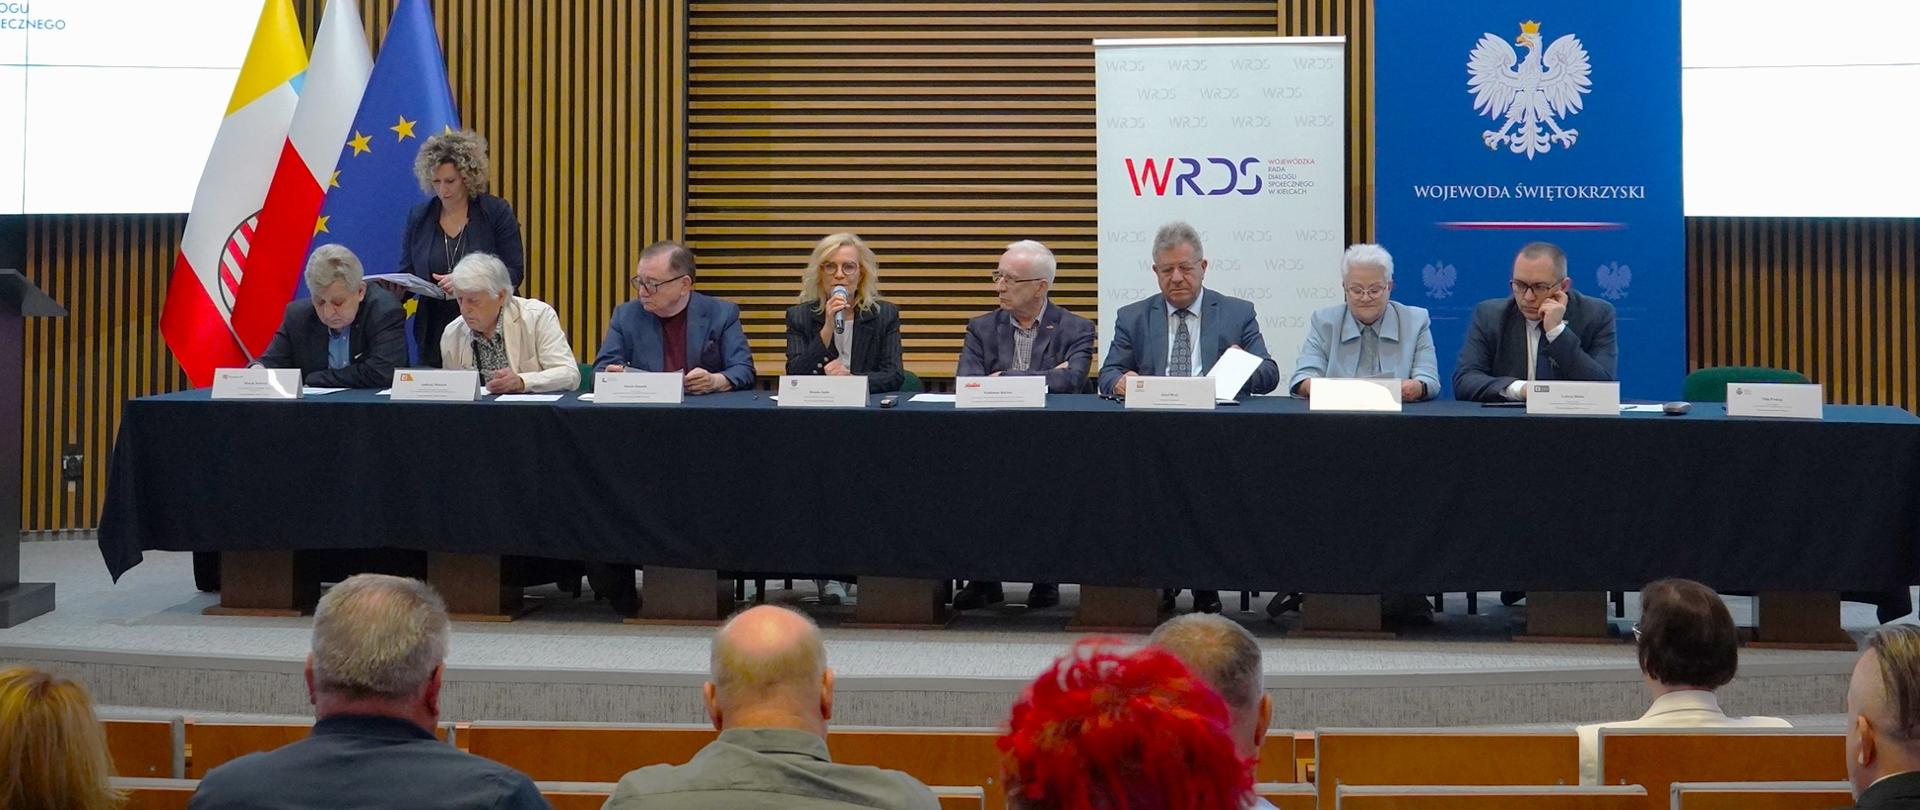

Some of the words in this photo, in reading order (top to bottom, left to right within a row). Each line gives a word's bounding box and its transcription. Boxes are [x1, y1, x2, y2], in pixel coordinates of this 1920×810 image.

[0, 3, 29, 13] OGU
[1105, 60, 1145, 72] WRDS
[1168, 59, 1208, 71] WRDS
[1231, 58, 1271, 70] WRDS
[1293, 57, 1334, 69] WRDS
[1137, 88, 1177, 100] WRDS
[1200, 87, 1239, 99] WRDS
[1262, 87, 1303, 98] WRDS
[1106, 117, 1145, 128] WRDS
[1169, 116, 1208, 128] WRDS
[1232, 115, 1271, 127] WRDS
[1294, 115, 1334, 127] WRDS
[1124, 157, 1263, 196] WRDS
[1414, 185, 1511, 201] WOJEWODA
[1515, 182, 1646, 202] ŚWIĘTOKRZYSKI
[1107, 231, 1146, 243] WRDS
[1233, 230, 1272, 242] WRDS
[1296, 230, 1336, 242] WRDS
[1265, 259, 1304, 271] WRDS
[1297, 287, 1337, 299] WRDS
[1265, 316, 1305, 328] WRDS
